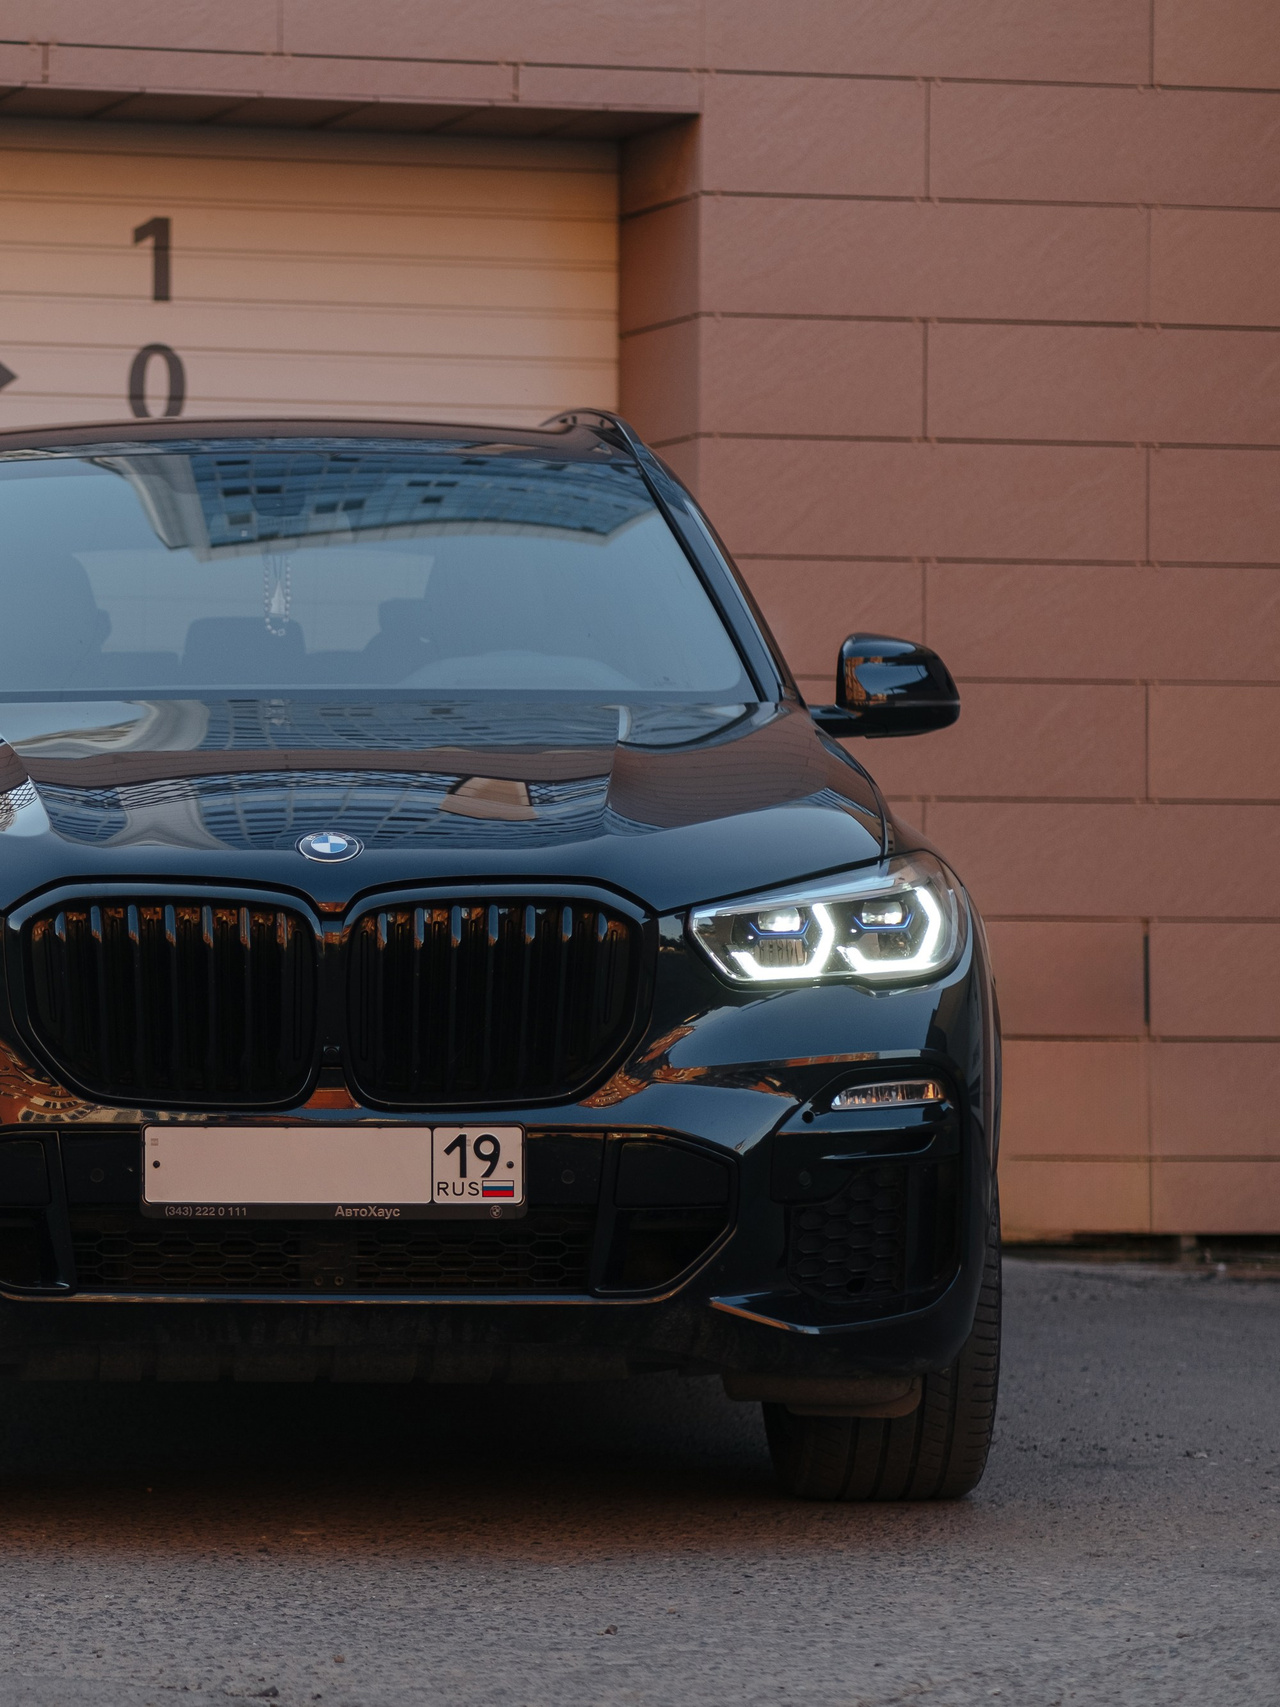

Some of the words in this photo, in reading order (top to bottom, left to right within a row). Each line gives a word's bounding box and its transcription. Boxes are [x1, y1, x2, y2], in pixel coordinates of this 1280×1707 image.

[132, 217, 172, 302] 1
[128, 343, 186, 418] 0
[443, 1133, 501, 1178] 19
[437, 1181, 480, 1196] RUS
[165, 1206, 193, 1216] (343)
[195, 1206, 216, 1216] 222
[218, 1206, 225, 1216] 0
[228, 1206, 248, 1216] 111
[334, 1205, 401, 1219] АвтоХаус
